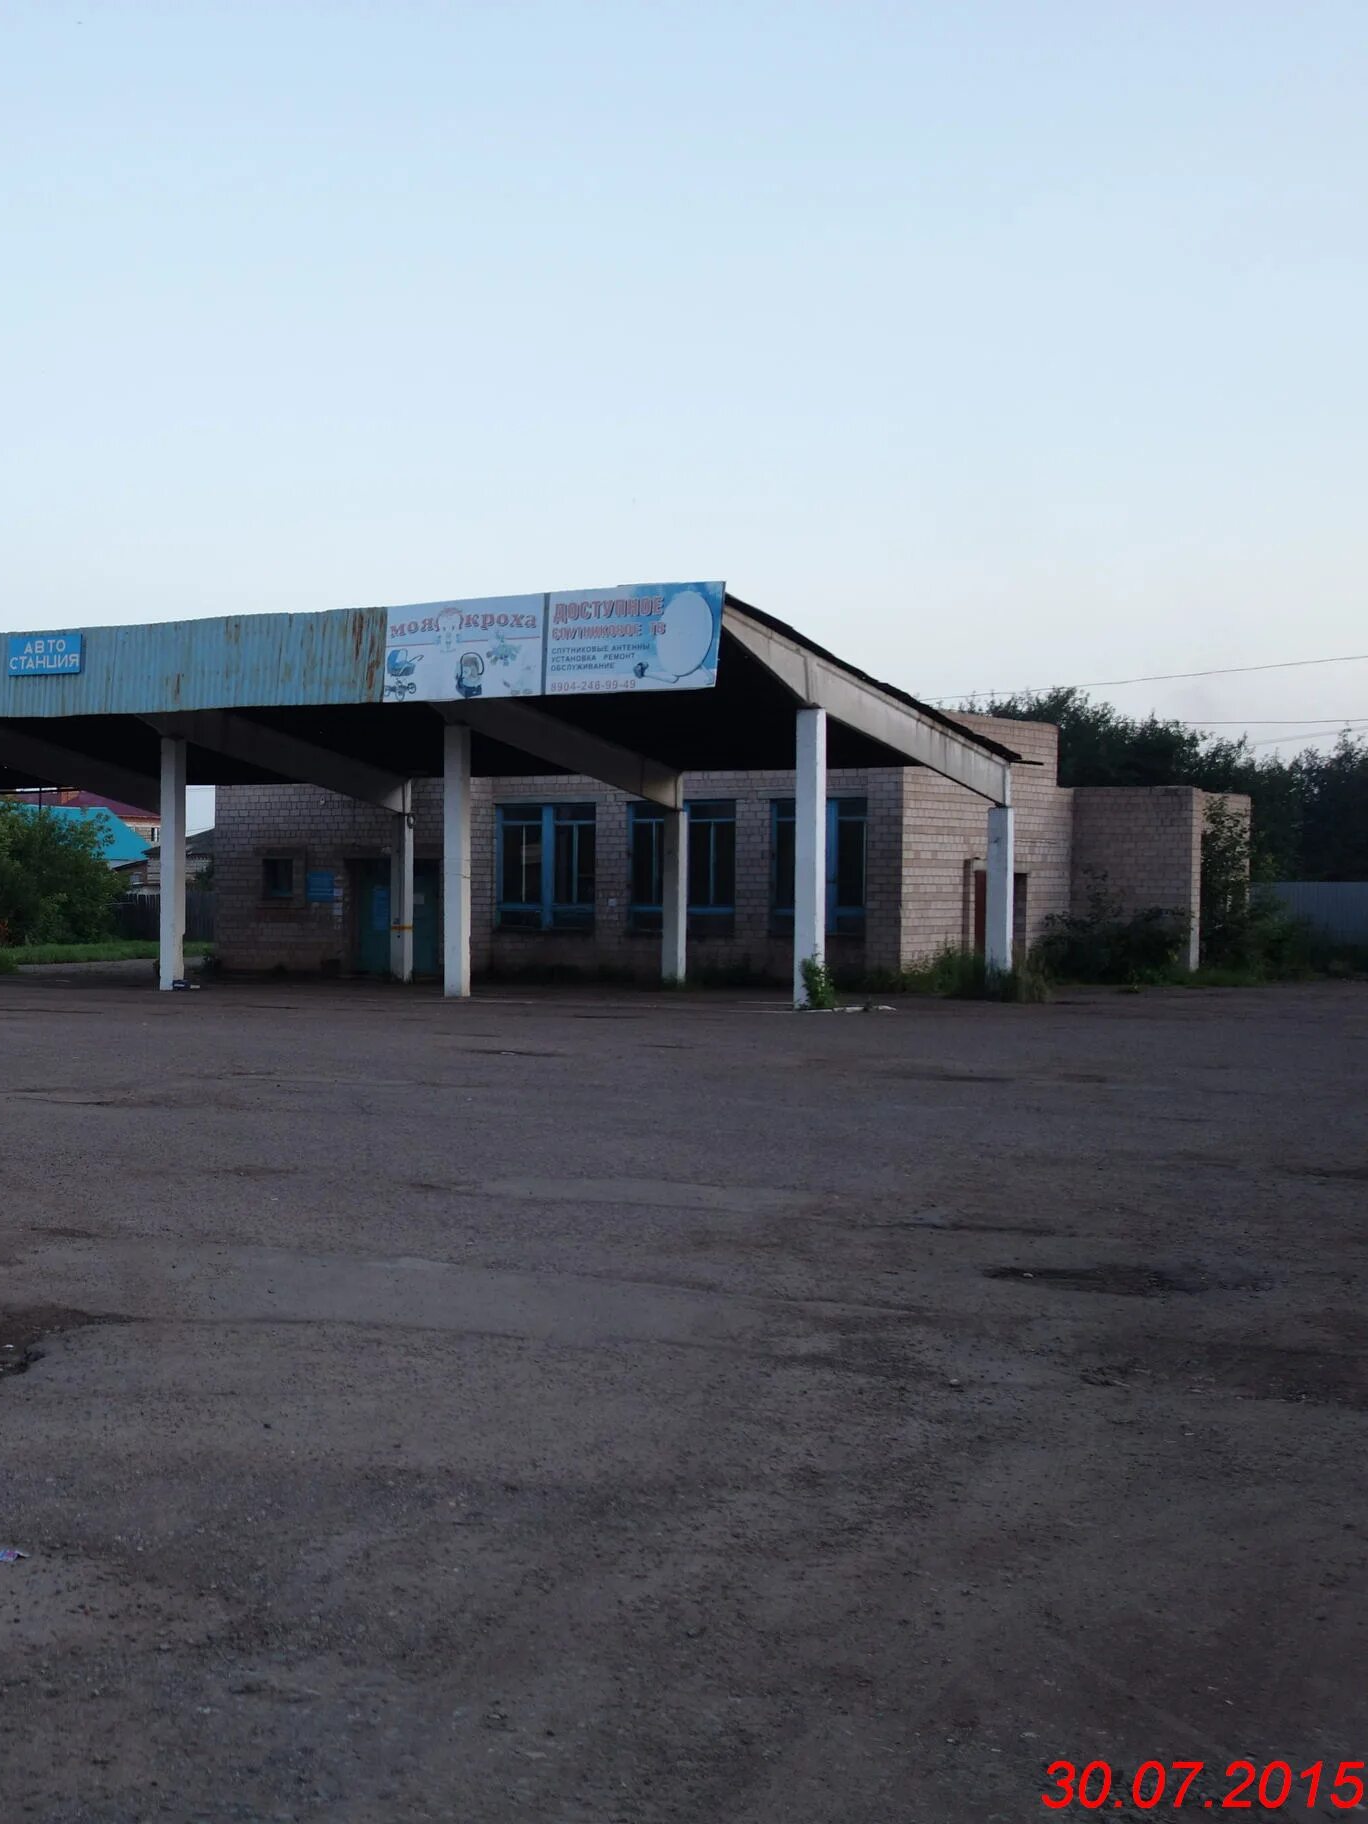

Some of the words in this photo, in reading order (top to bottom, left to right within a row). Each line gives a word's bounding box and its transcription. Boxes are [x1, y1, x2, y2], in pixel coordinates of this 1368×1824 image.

[553, 595, 666, 624] ДОСТУПНОЕ
[551, 623, 643, 641] СПУТНИКОВОЕ
[650, 621, 667, 636] ТВ
[23, 639, 66, 655] АВТО
[551, 644, 609, 655] СПУТНИКОВЫЕ
[611, 642, 651, 652] АНТЕННЫ
[9, 653, 80, 670] СТАНЦИЯ
[551, 654, 597, 664] УСТАНОВКА
[603, 652, 635, 661] РЕМОНТ
[550, 662, 615, 672] ОБСЛУЖИВАНИЕ
